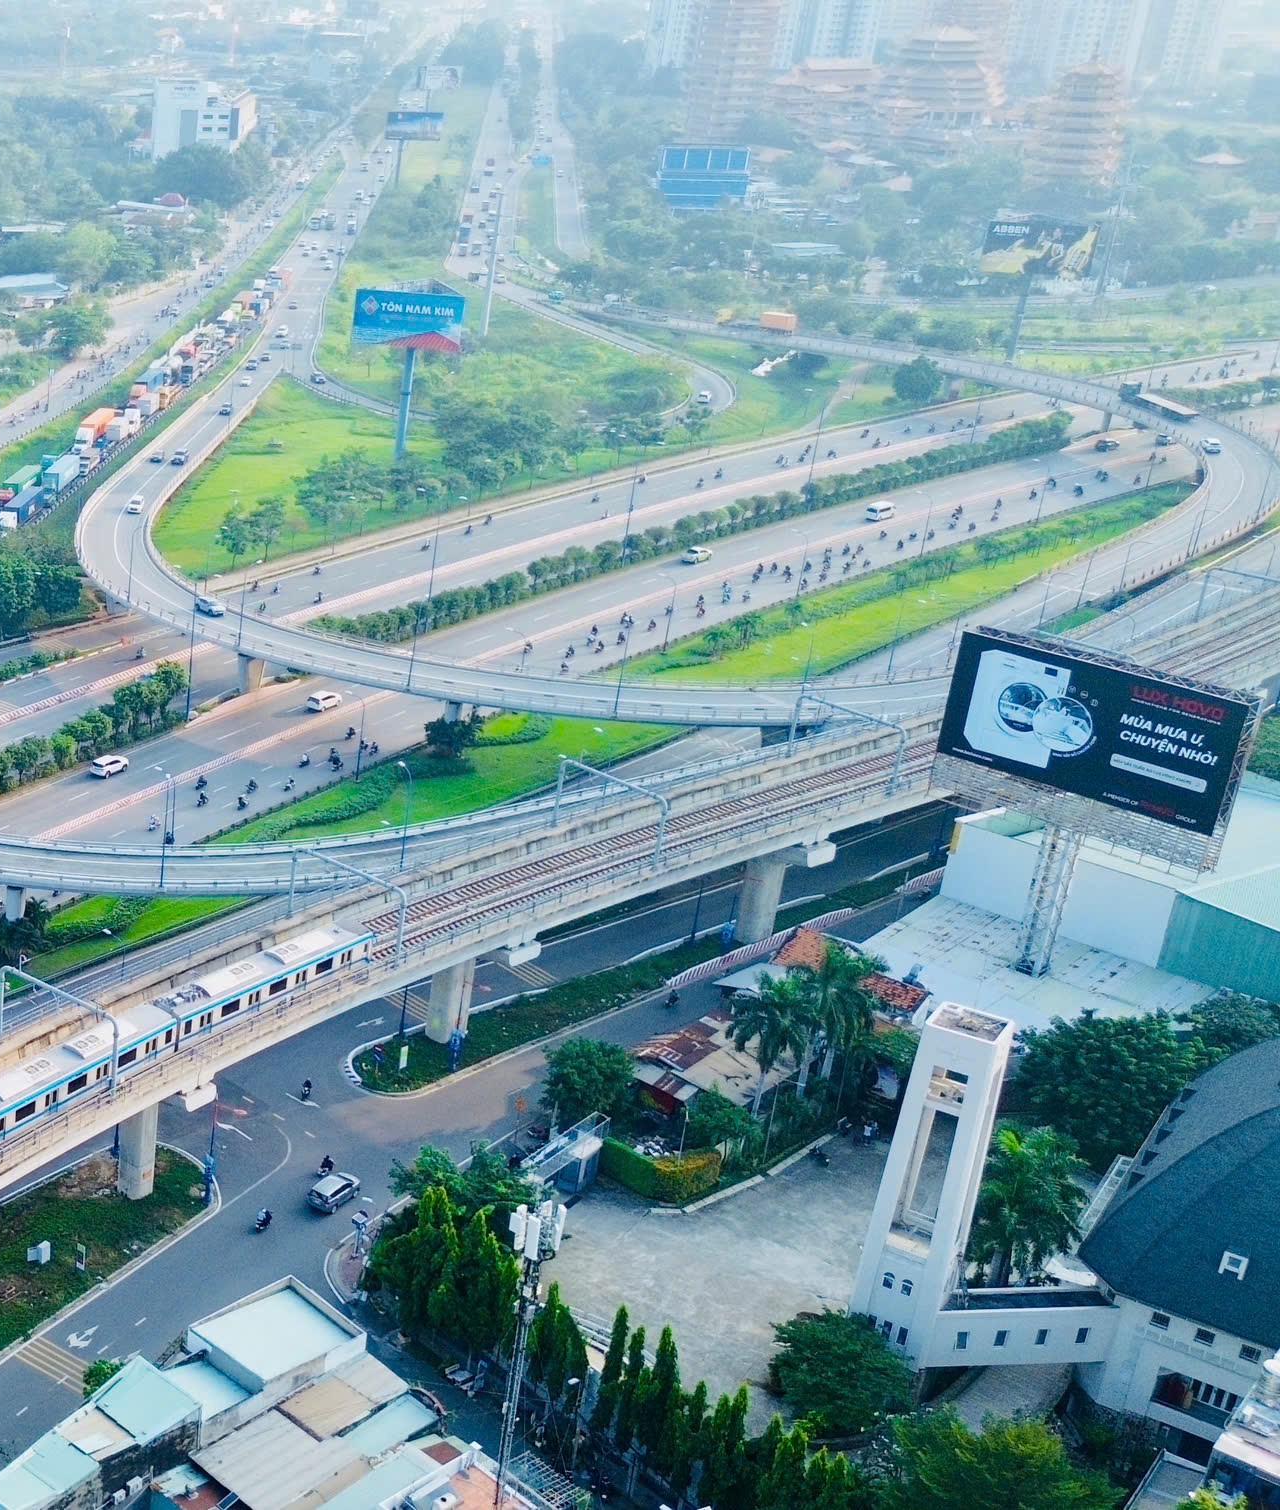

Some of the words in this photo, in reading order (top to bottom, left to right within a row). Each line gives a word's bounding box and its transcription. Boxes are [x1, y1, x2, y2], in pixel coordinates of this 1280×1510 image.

[381, 301, 403, 313] TÔN
[405, 304, 431, 315] NAM
[434, 306, 455, 317] KIM
[1120, 713, 1152, 731] MÙA
[1154, 723, 1187, 741] MƯA
[1120, 731, 1178, 753] CHUYỆN
[1178, 747, 1219, 766] NHỎ!
[1175, 814, 1197, 824] GROUP
